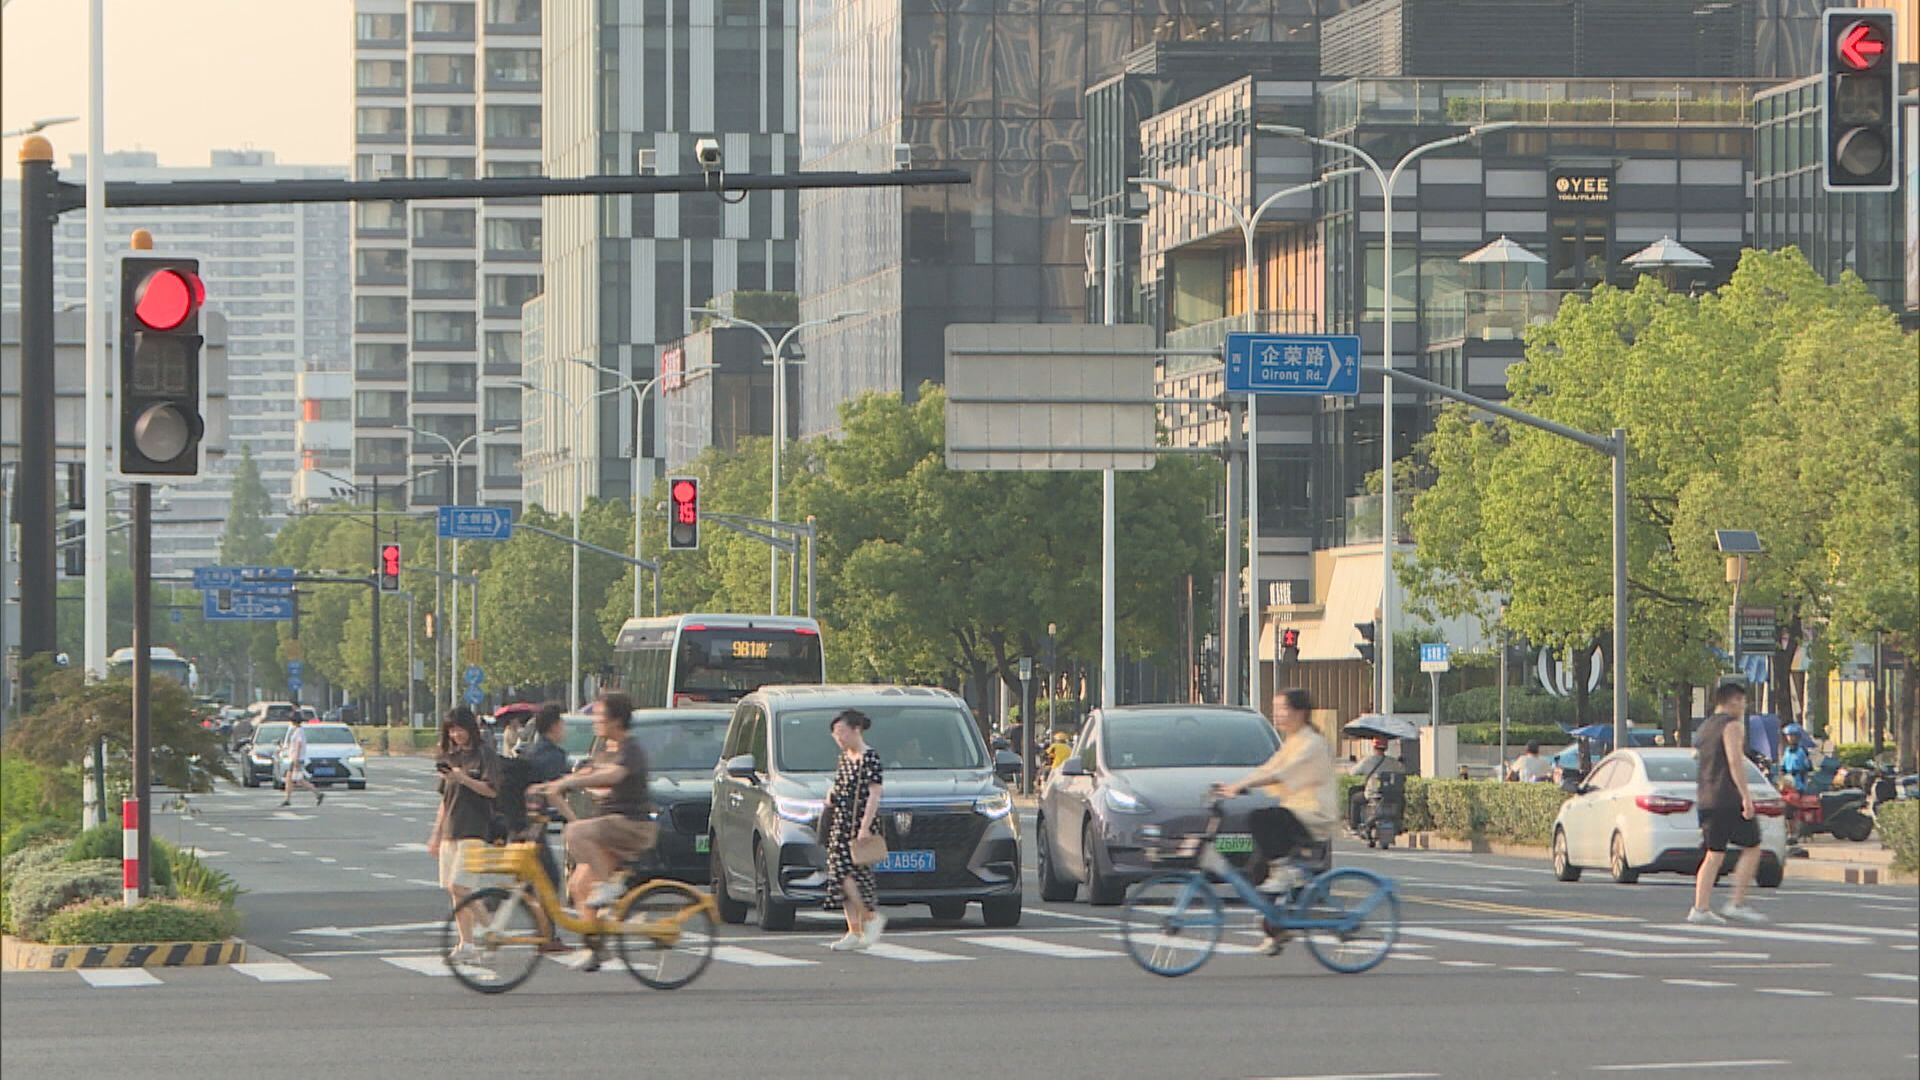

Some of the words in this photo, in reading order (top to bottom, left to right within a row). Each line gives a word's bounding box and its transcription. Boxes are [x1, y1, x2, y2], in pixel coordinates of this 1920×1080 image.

[1261, 345, 1325, 366] 企荣路
[1262, 367, 1299, 383] Qirong
[1306, 369, 1323, 380] Rd.
